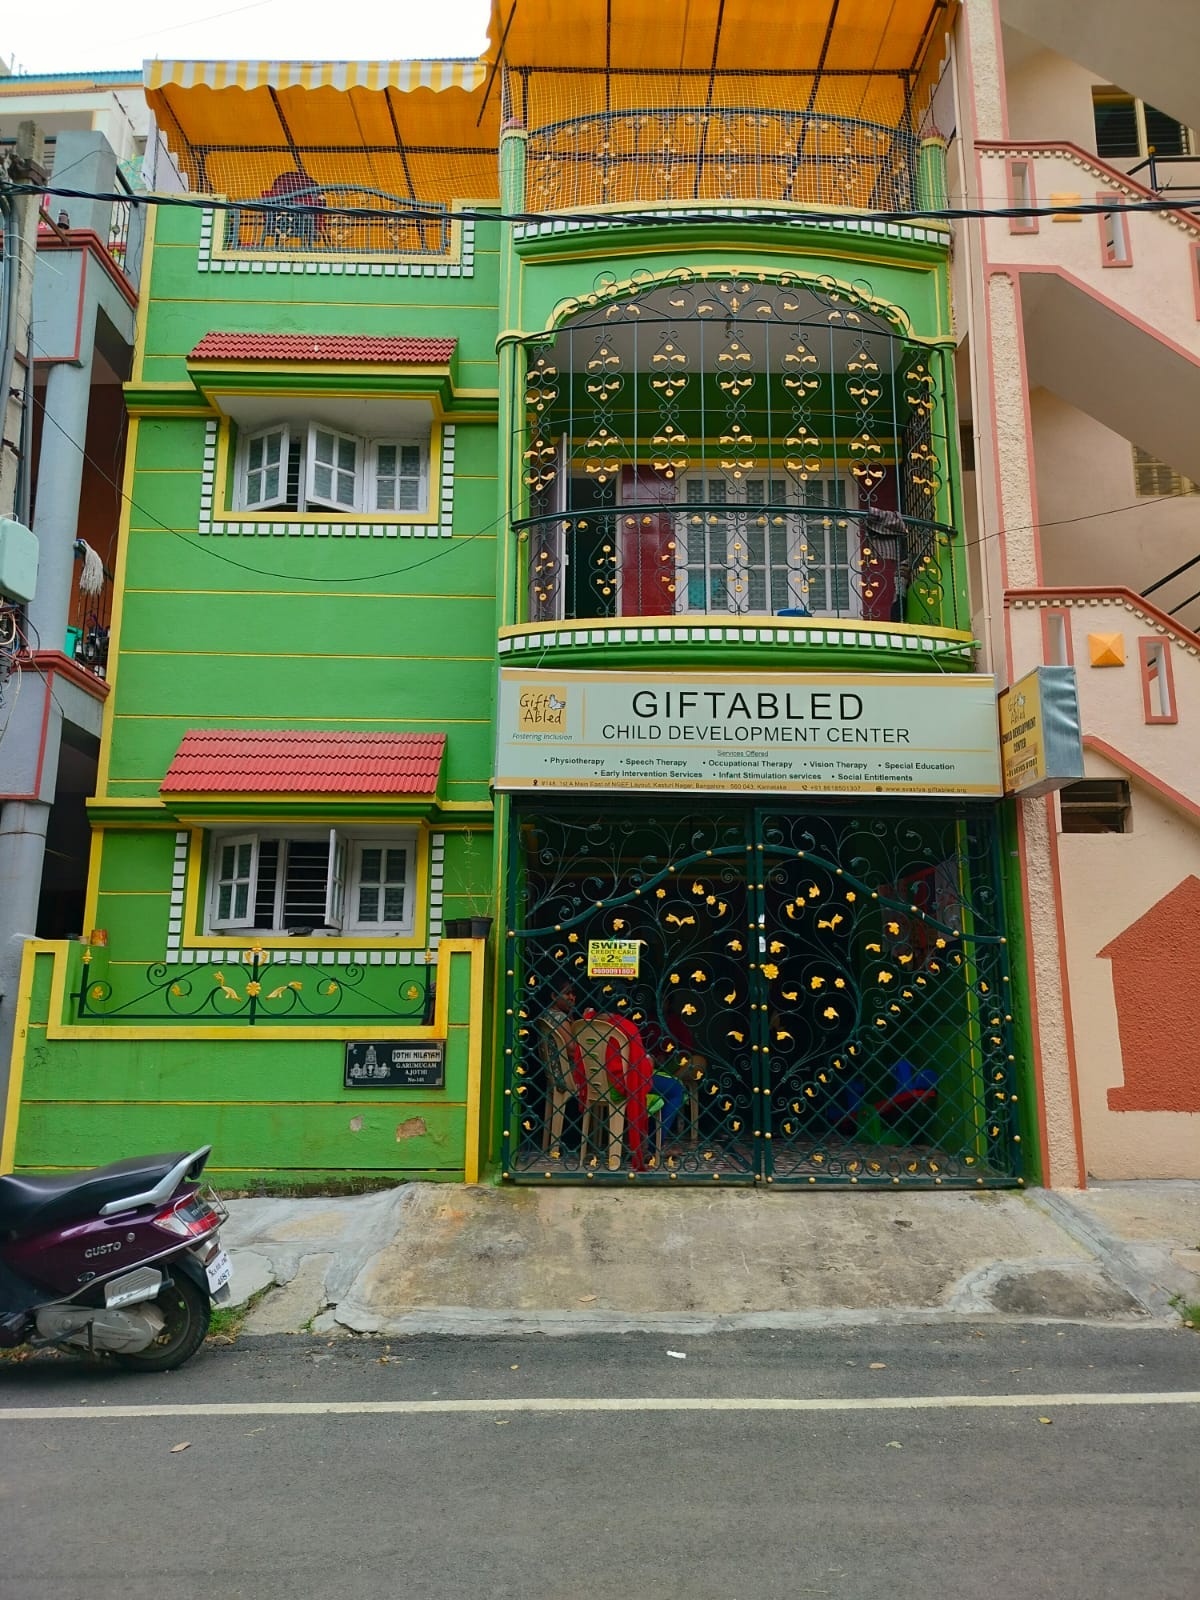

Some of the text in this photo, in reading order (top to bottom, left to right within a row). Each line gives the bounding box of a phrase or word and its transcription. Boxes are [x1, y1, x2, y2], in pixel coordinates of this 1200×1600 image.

[519, 693, 550, 711] Gift
[632, 690, 863, 720] GIFTABLED
[523, 709, 562, 724] Abled
[512, 733, 542, 741] Fostering
[602, 724, 910, 744] CHILD DEVELOPMENT CENTER
[745, 750, 769, 758] Offered
[550, 757, 605, 766] Physiotherapy
[625, 758, 687, 768] Speech Therapy
[708, 760, 793, 770] Occupational Therapy
[809, 761, 868, 771] Vision Therapy
[884, 762, 955, 771] Special Education
[600, 770, 703, 780] Early Intervention Services
[718, 771, 822, 781] Infant Stimulation services
[838, 773, 913, 782] Social Entitlements
[591, 942, 637, 950] SWIPE
[393, 1051, 441, 1060] JOTHI NILAYAM
[84, 1241, 122, 1259] GUSTO
